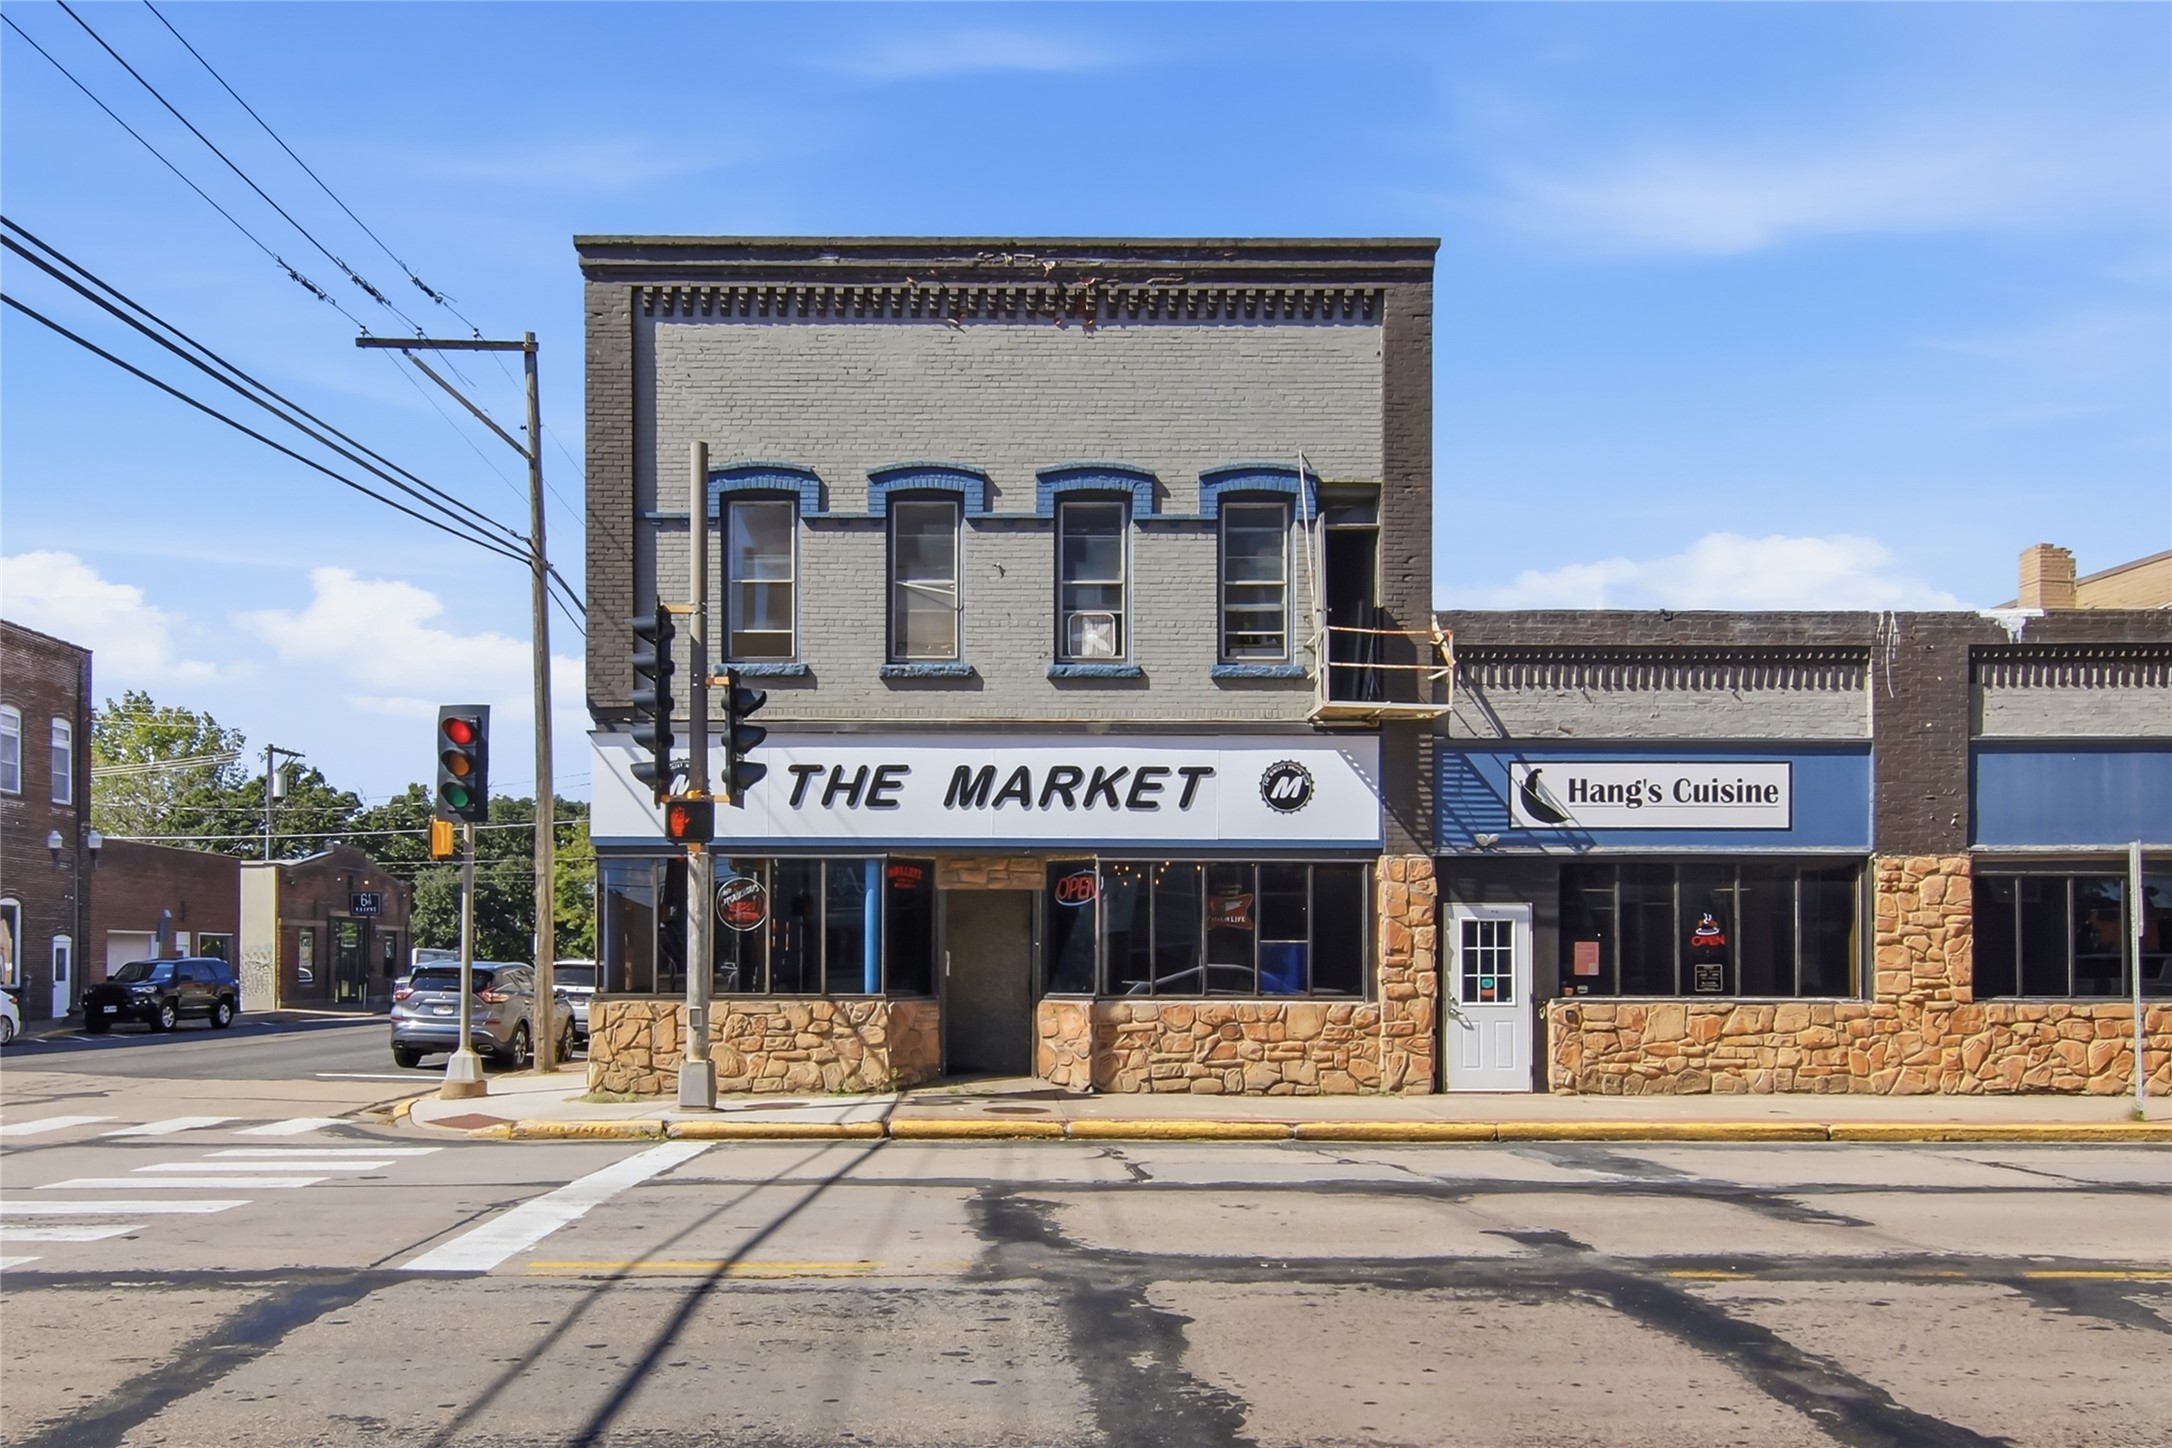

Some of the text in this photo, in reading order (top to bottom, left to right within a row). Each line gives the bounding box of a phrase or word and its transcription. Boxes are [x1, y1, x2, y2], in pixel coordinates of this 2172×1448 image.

[787, 764, 911, 808] THE
[943, 765, 1216, 809] MARKET
[1270, 776, 1303, 799] M
[1568, 777, 1779, 809] Hang's Cuisine
[1057, 877, 1096, 899] OPEN
[1691, 935, 1726, 947] OPEN
